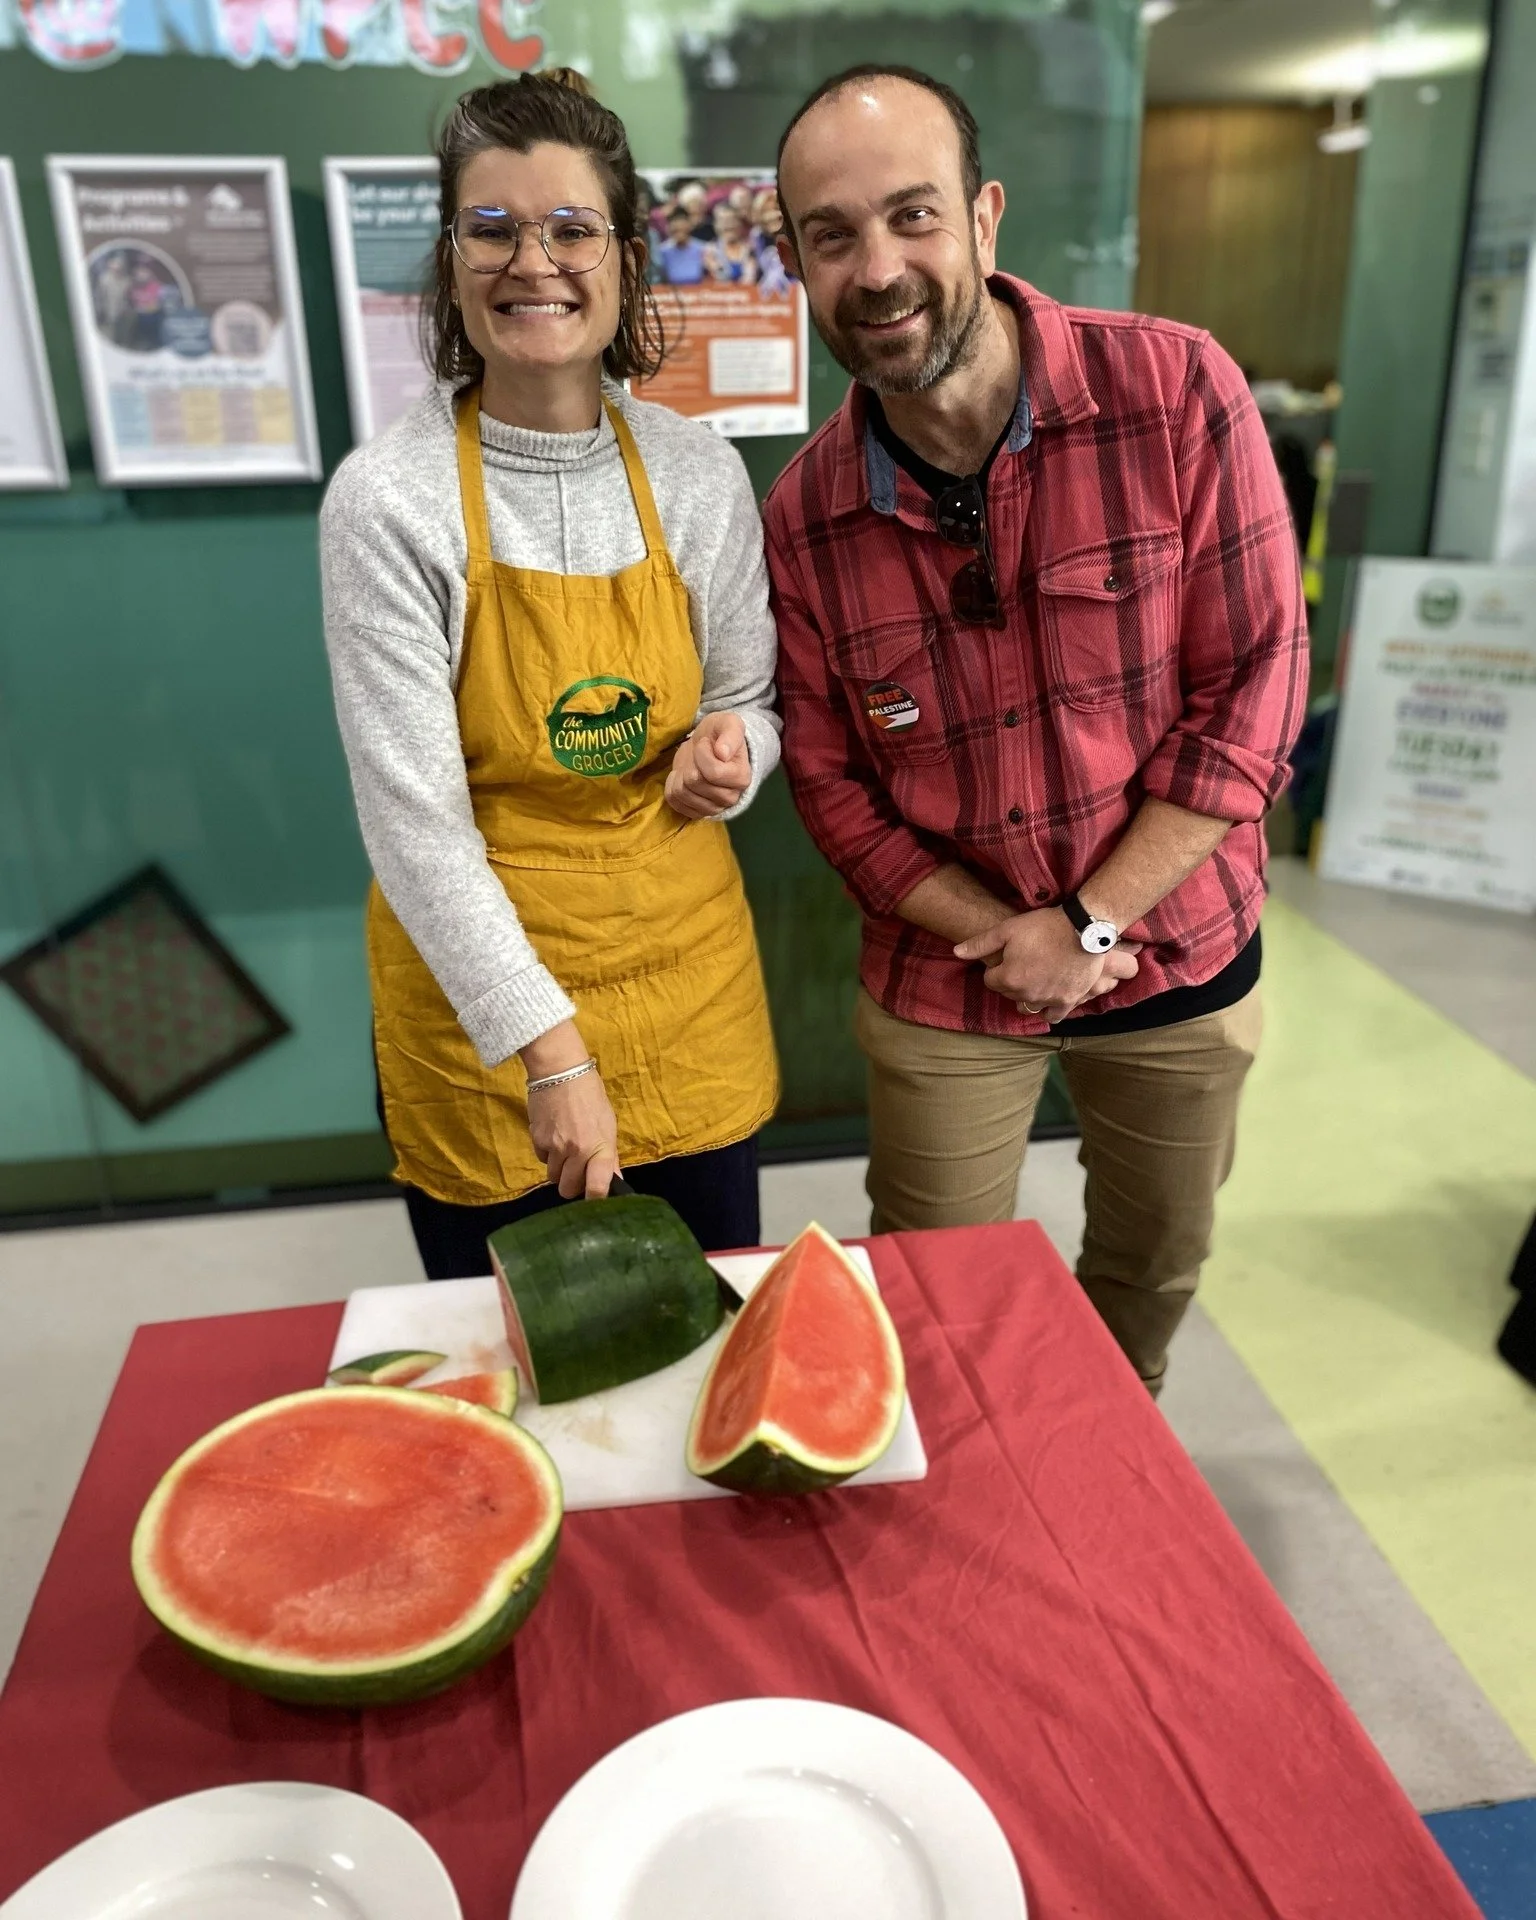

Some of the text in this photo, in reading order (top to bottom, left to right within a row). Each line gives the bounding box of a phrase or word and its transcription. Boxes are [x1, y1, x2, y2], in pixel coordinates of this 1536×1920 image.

[867, 688, 904, 706] FREE
[868, 700, 914, 716] PALESTINE
[563, 716, 583, 728] the
[555, 713, 643, 751] COMMUNITY
[572, 743, 637, 771] GROCER
